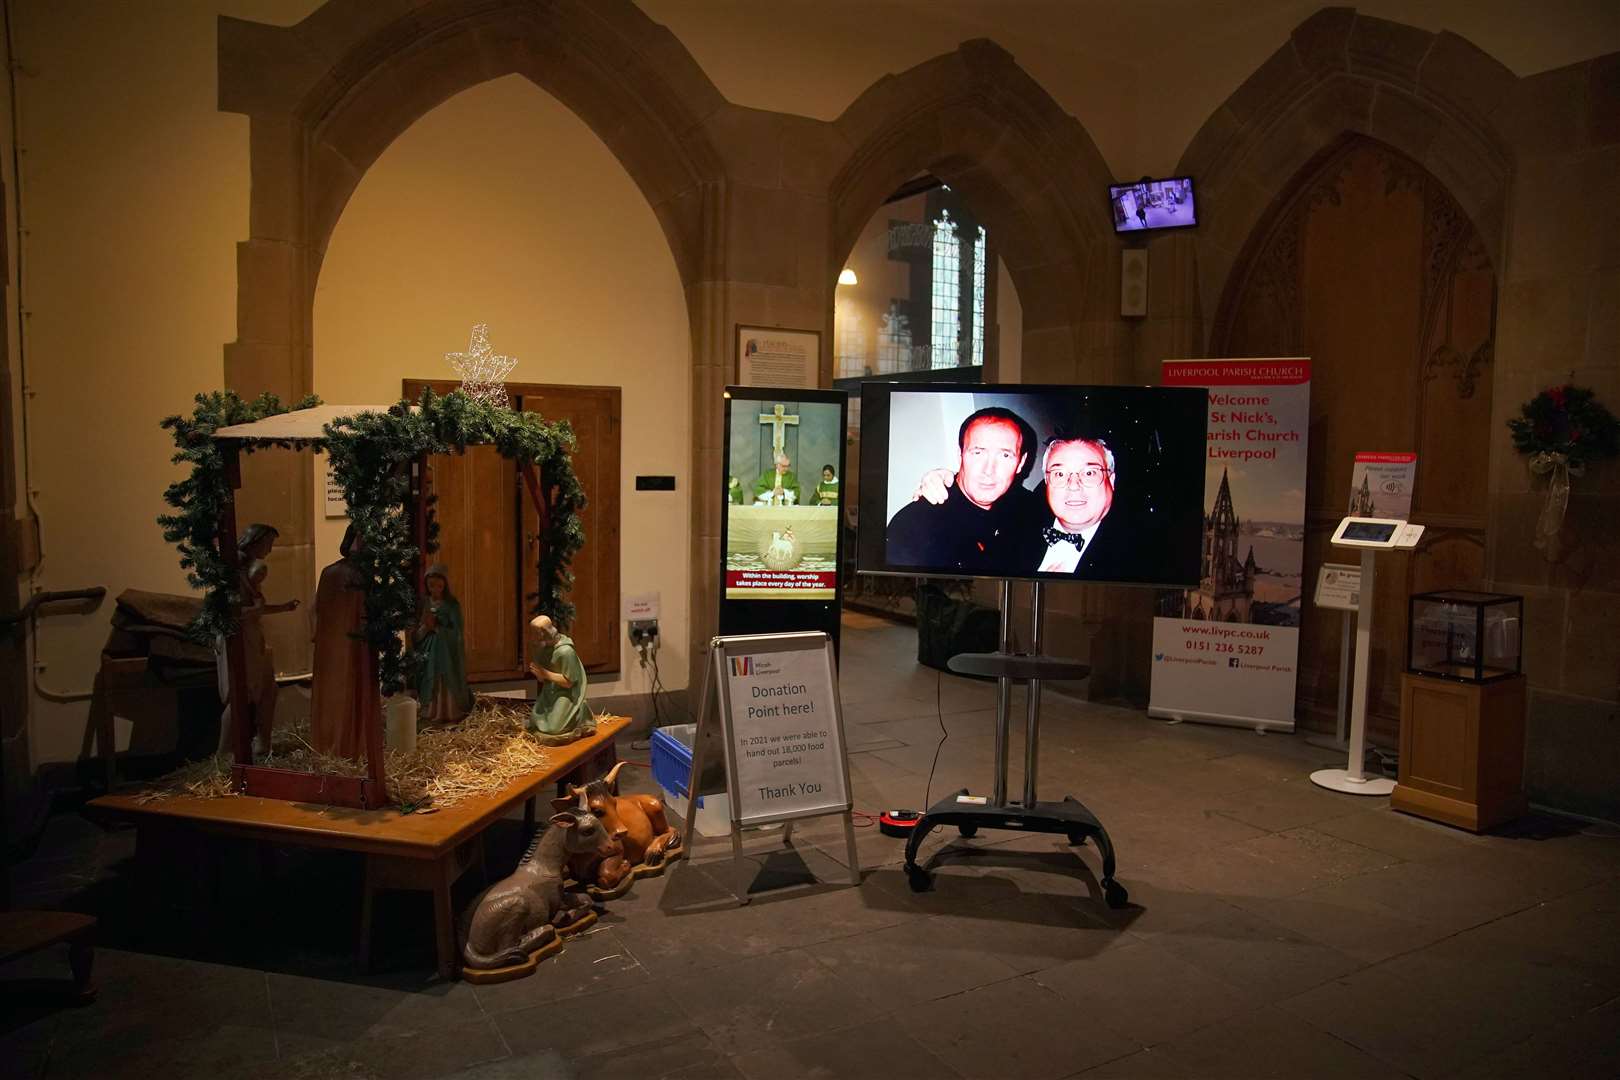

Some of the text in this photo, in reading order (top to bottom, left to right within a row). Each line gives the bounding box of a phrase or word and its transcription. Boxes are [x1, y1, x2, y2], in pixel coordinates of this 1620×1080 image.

[1168, 367, 1303, 377] LIVERPOOL PARISH CHURCH
[1210, 410, 1277, 424] St Nick's,
[1207, 429, 1299, 442] arish Church
[1208, 446, 1276, 462] Liverpool
[1182, 625, 1271, 640] www.livpc.co.uk
[1185, 640, 1265, 656] 0151 236 5287
[751, 682, 807, 698] Donation
[748, 700, 815, 719] Point here!
[740, 737, 748, 746] In
[750, 736, 768, 745] 2021
[782, 734, 801, 742] were
[802, 730, 818, 739] able
[819, 730, 828, 738] to
[746, 742, 825, 759] hand out 18,000 food
[773, 757, 802, 768] parcels!
[758, 783, 822, 801] Thank You
